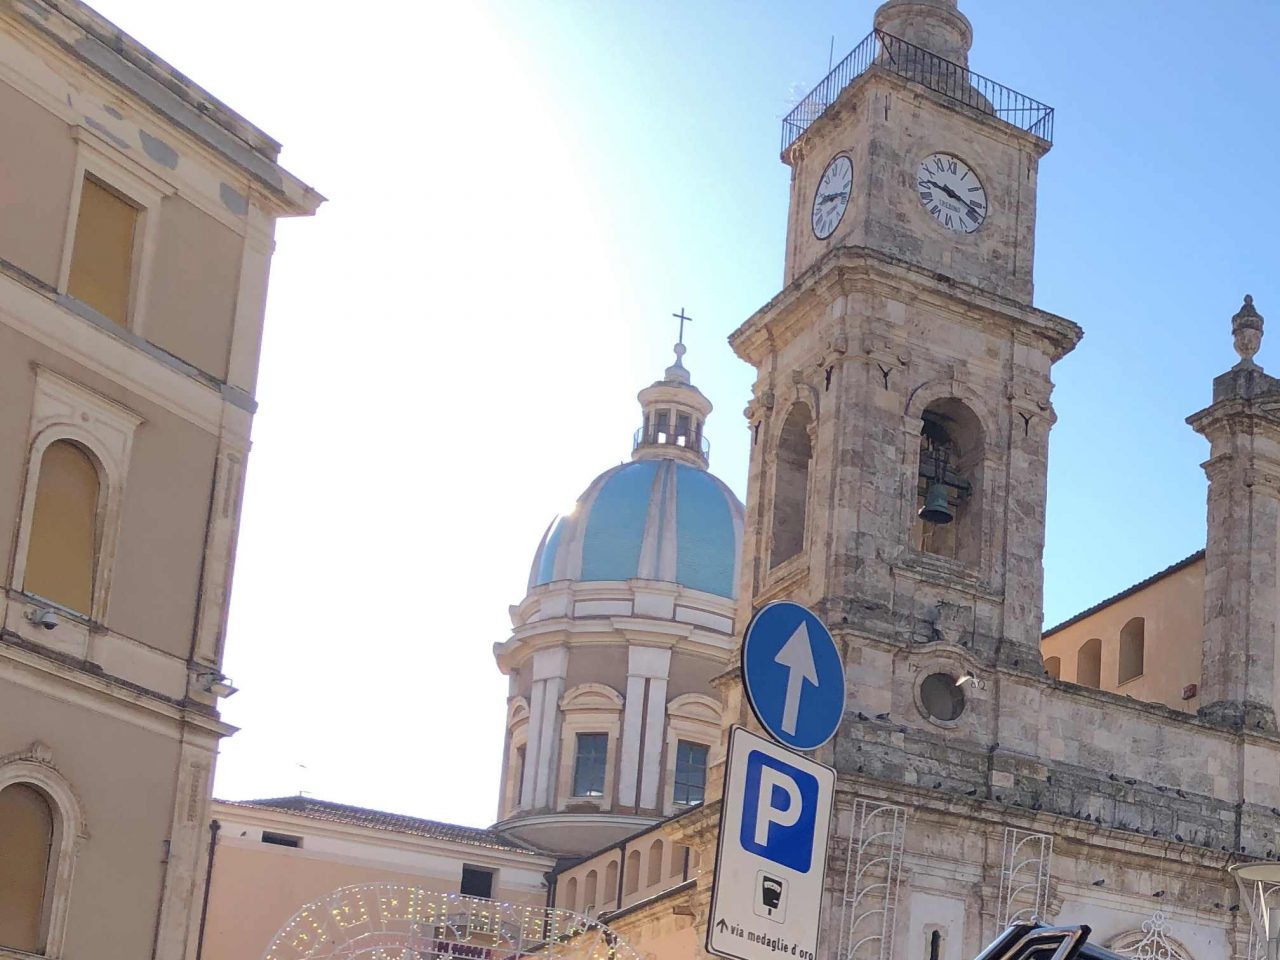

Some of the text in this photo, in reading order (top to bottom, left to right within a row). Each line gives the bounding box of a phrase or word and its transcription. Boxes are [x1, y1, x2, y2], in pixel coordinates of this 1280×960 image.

[754, 765, 803, 847] P
[730, 923, 744, 938] via
[747, 931, 789, 952] medaglie
